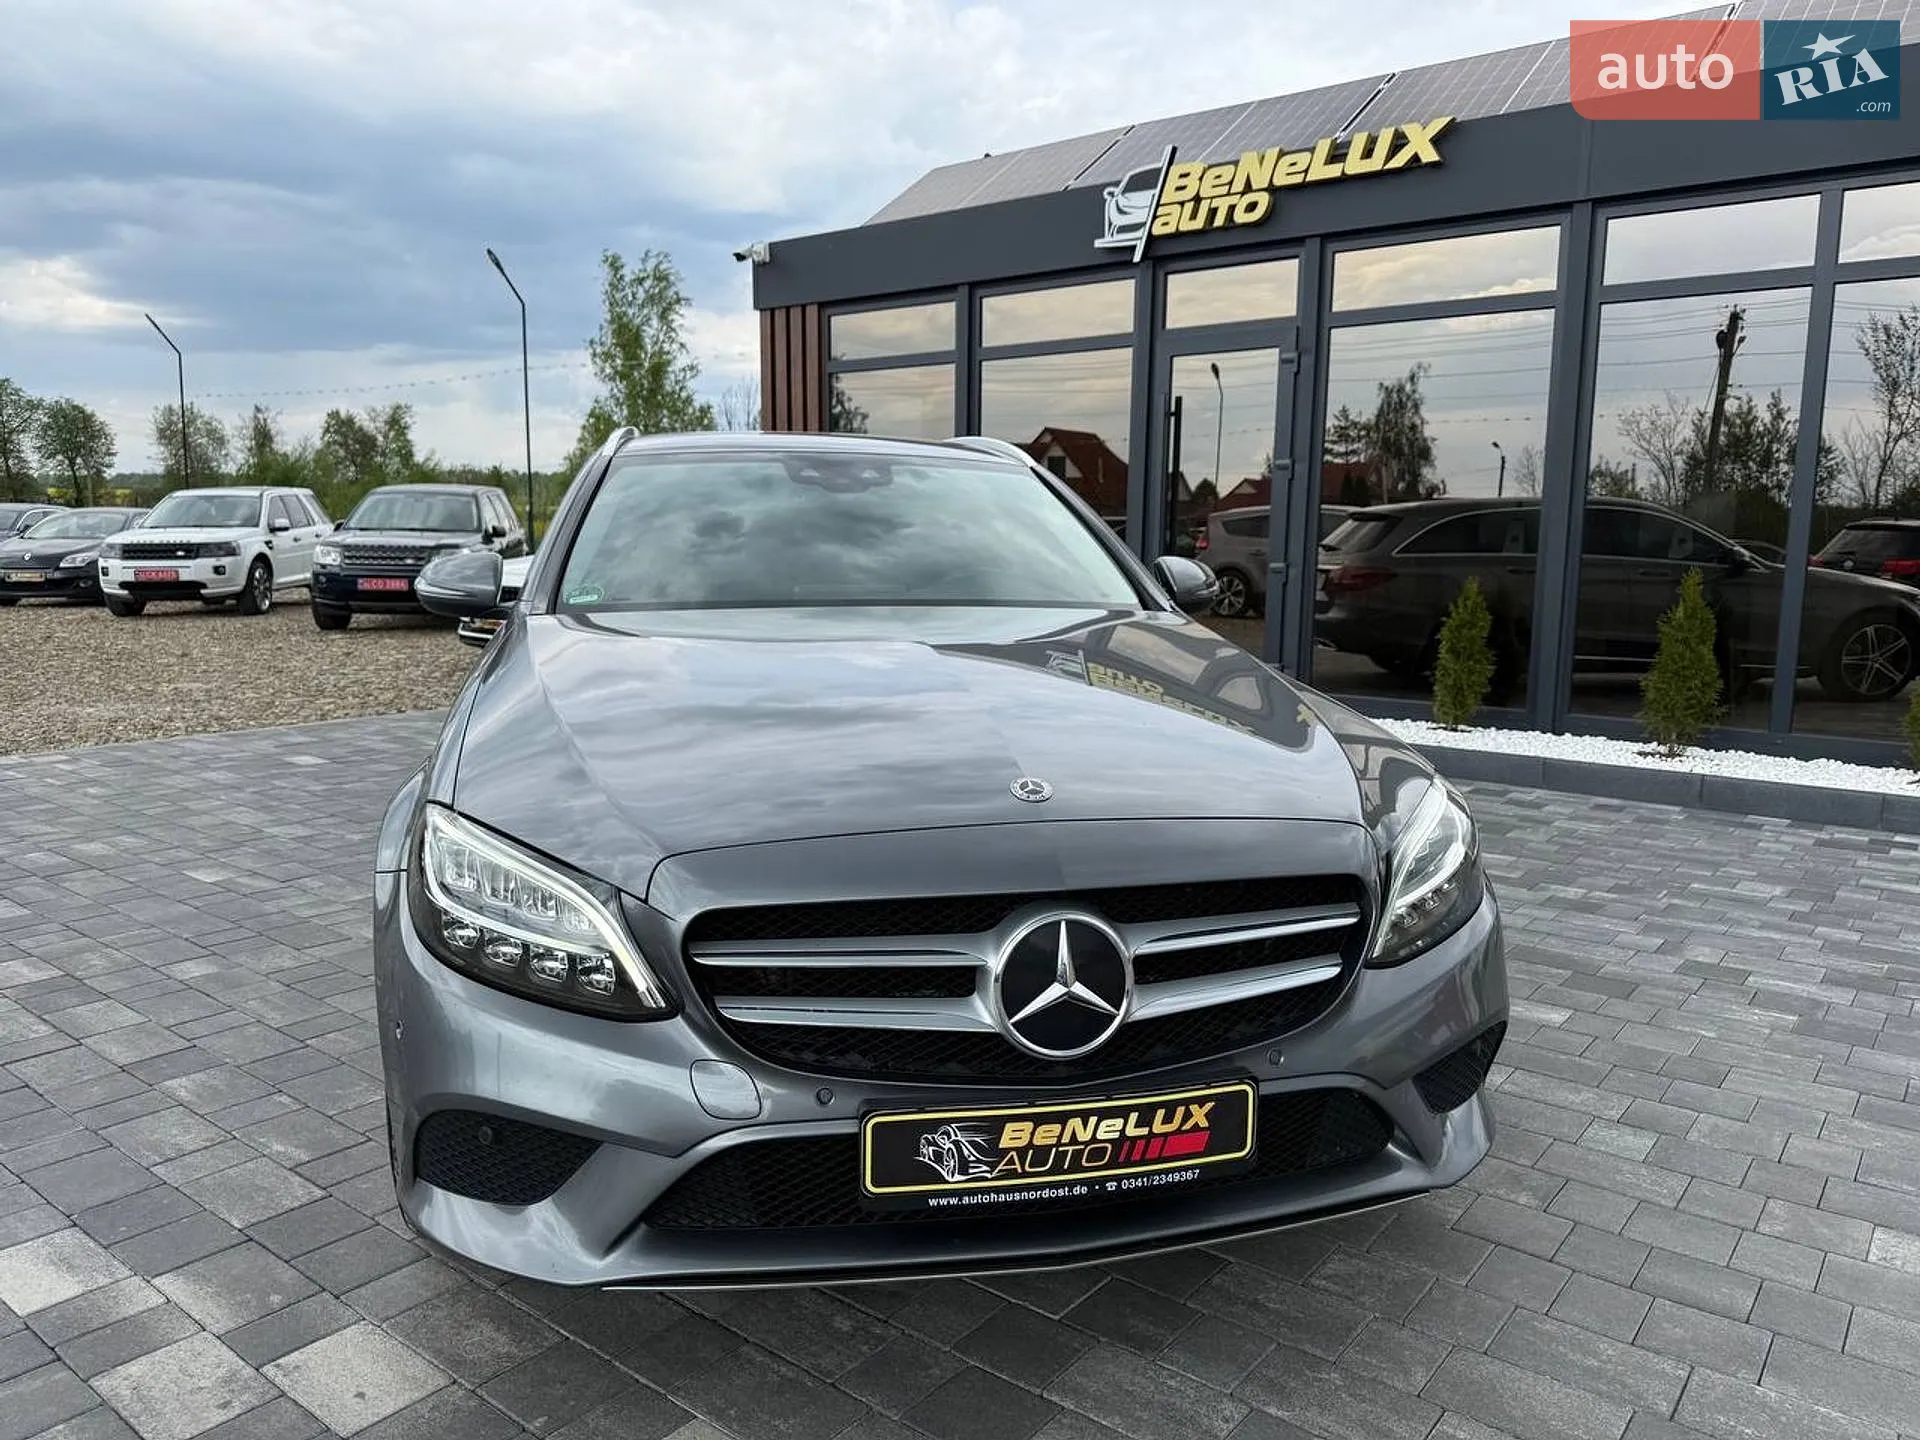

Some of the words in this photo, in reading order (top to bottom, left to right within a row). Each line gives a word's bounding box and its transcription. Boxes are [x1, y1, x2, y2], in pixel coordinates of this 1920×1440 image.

[1160, 116, 1456, 205] BeNeLUX
[999, 1102, 1215, 1148] BeNeLUX
[991, 1143, 1112, 1177] AUTO
[928, 1185, 1088, 1206] www.autohausnordost.de
[1121, 1169, 1200, 1189] 0341/2349367
